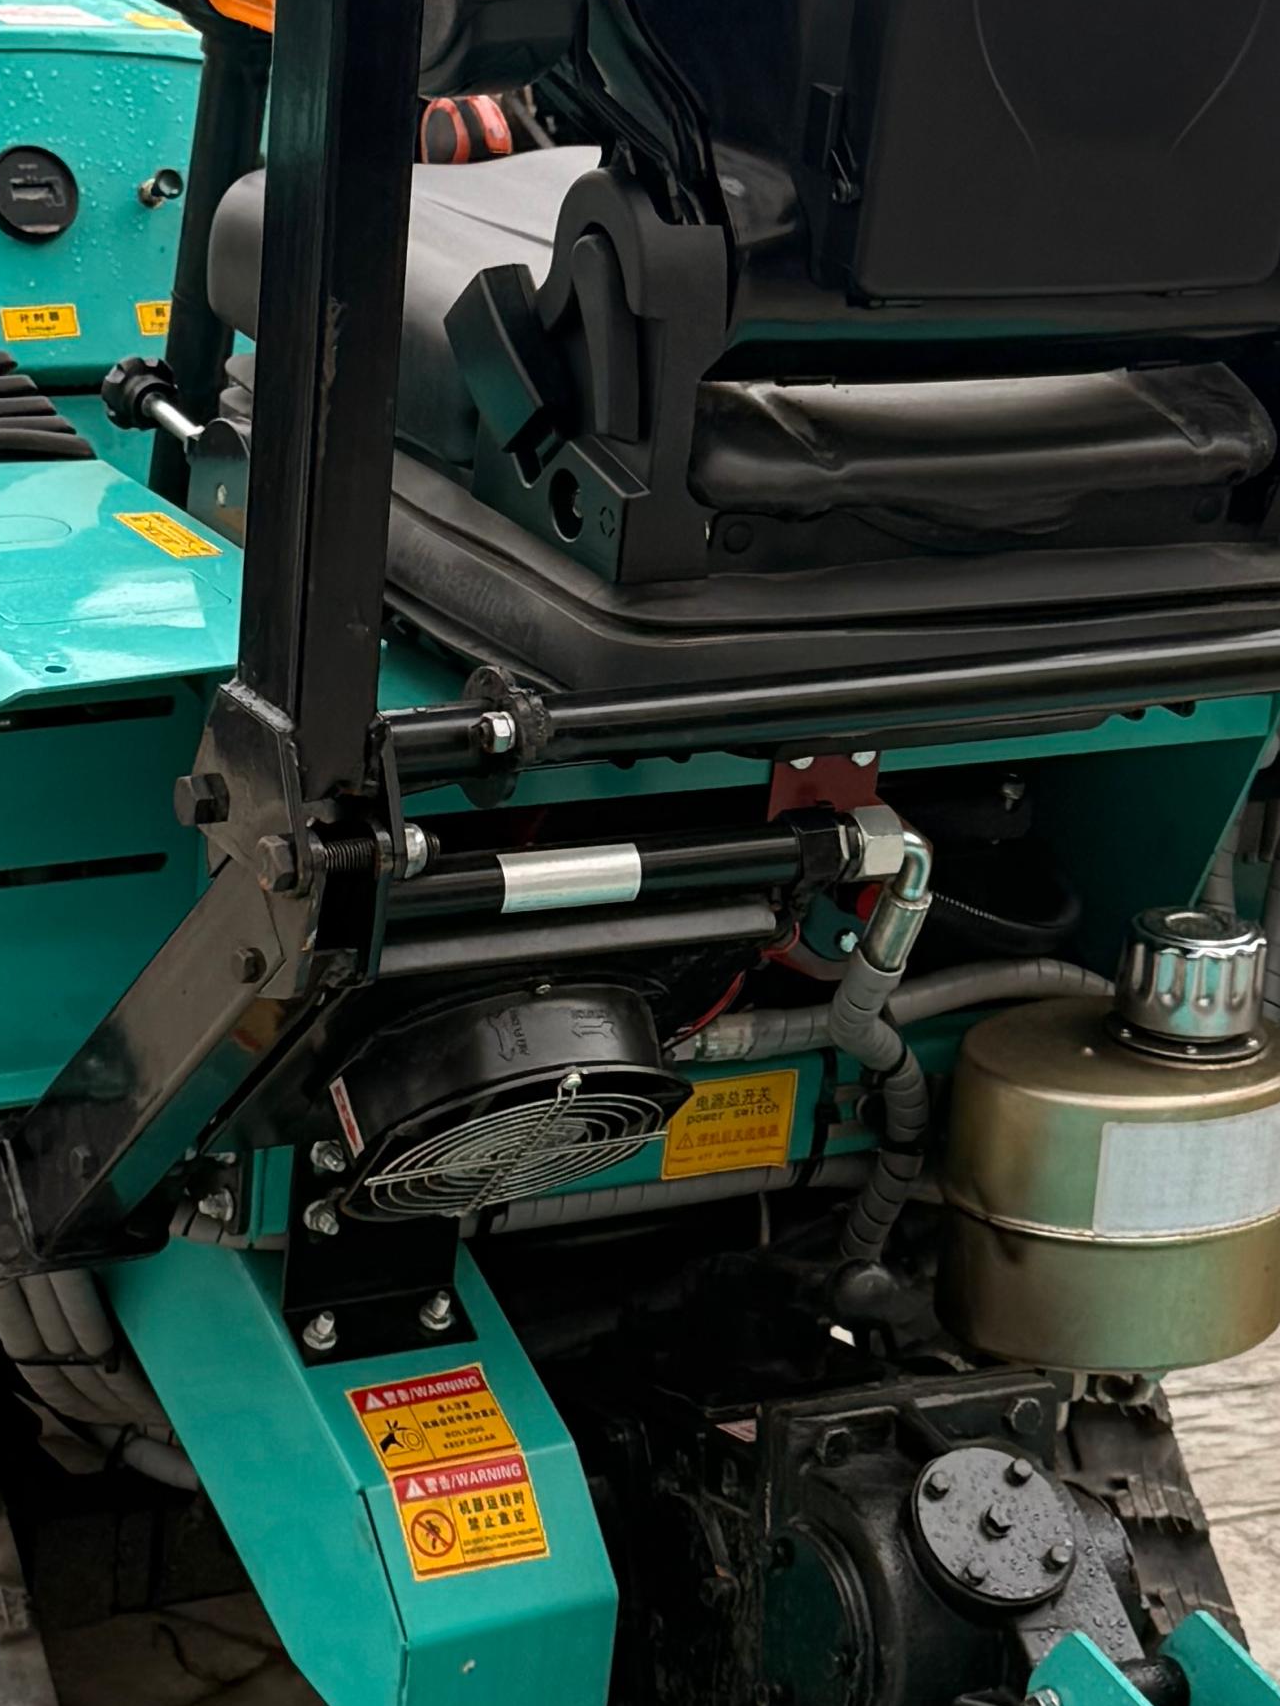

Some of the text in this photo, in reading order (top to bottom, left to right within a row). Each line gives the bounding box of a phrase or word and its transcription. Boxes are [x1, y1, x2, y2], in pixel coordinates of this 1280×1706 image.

[695, 1086, 772, 1111] 电源总开关
[686, 1103, 780, 1127] power switch
[426, 1462, 522, 1494] 警告/WARNING
